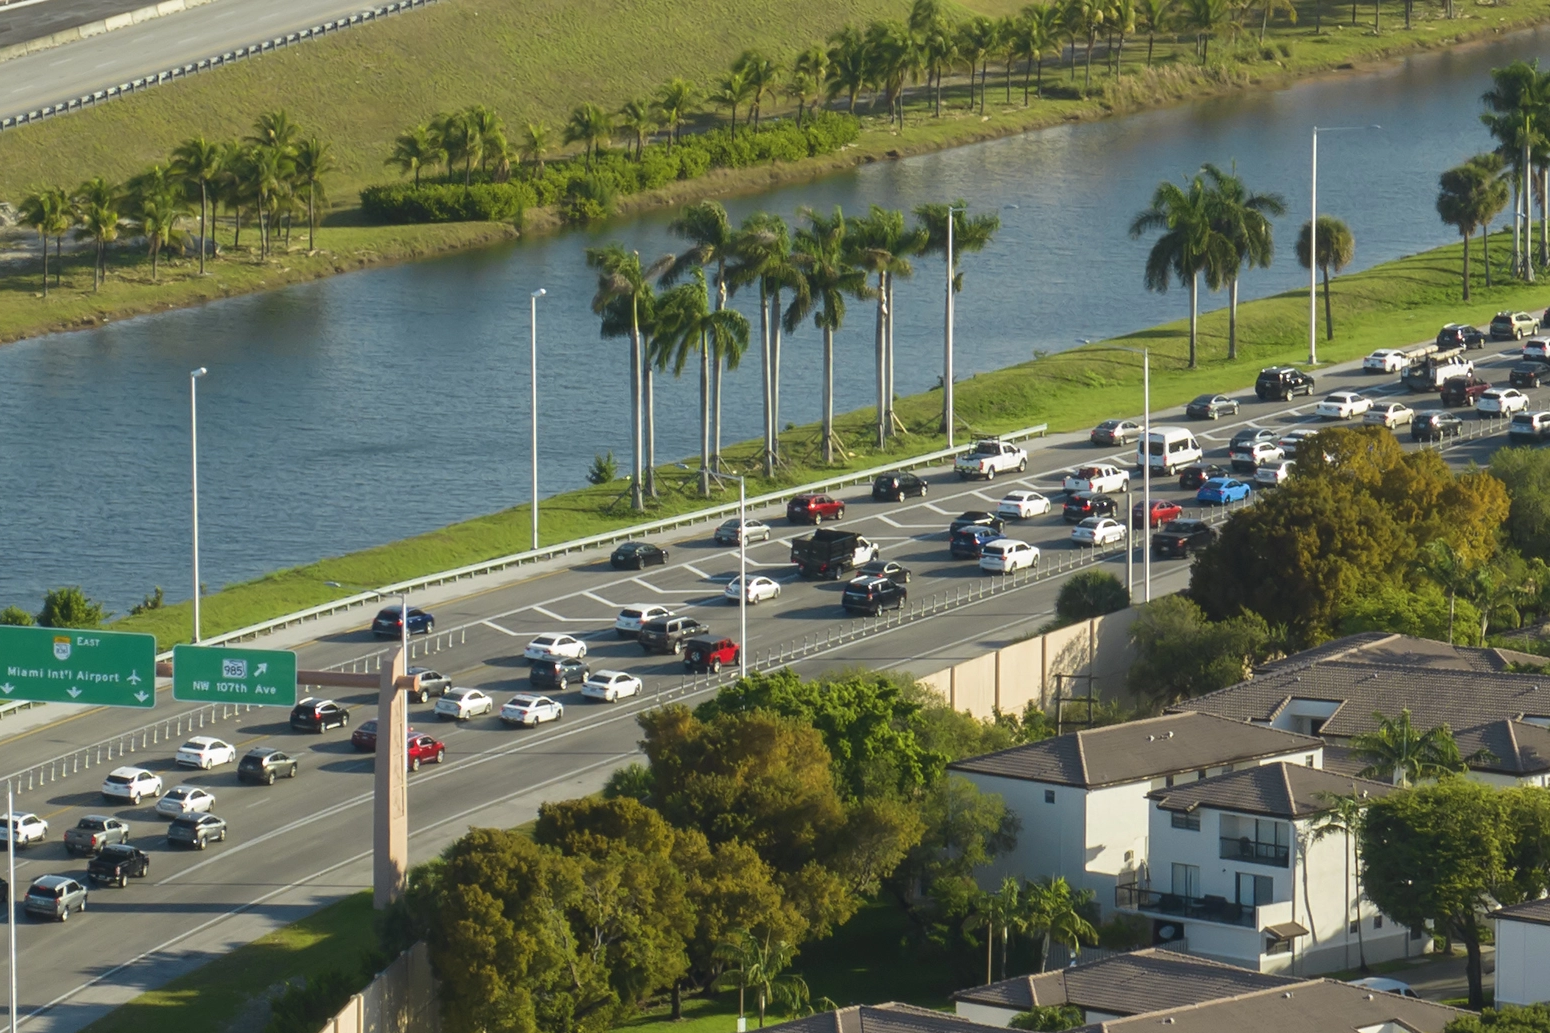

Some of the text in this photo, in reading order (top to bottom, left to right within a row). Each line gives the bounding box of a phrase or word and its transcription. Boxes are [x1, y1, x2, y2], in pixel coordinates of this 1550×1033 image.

[77, 636, 100, 647] EAST
[7, 666, 120, 683] Miami Int'l Airport
[224, 665, 243, 676] 985
[193, 681, 276, 695] NW 107th Ave
